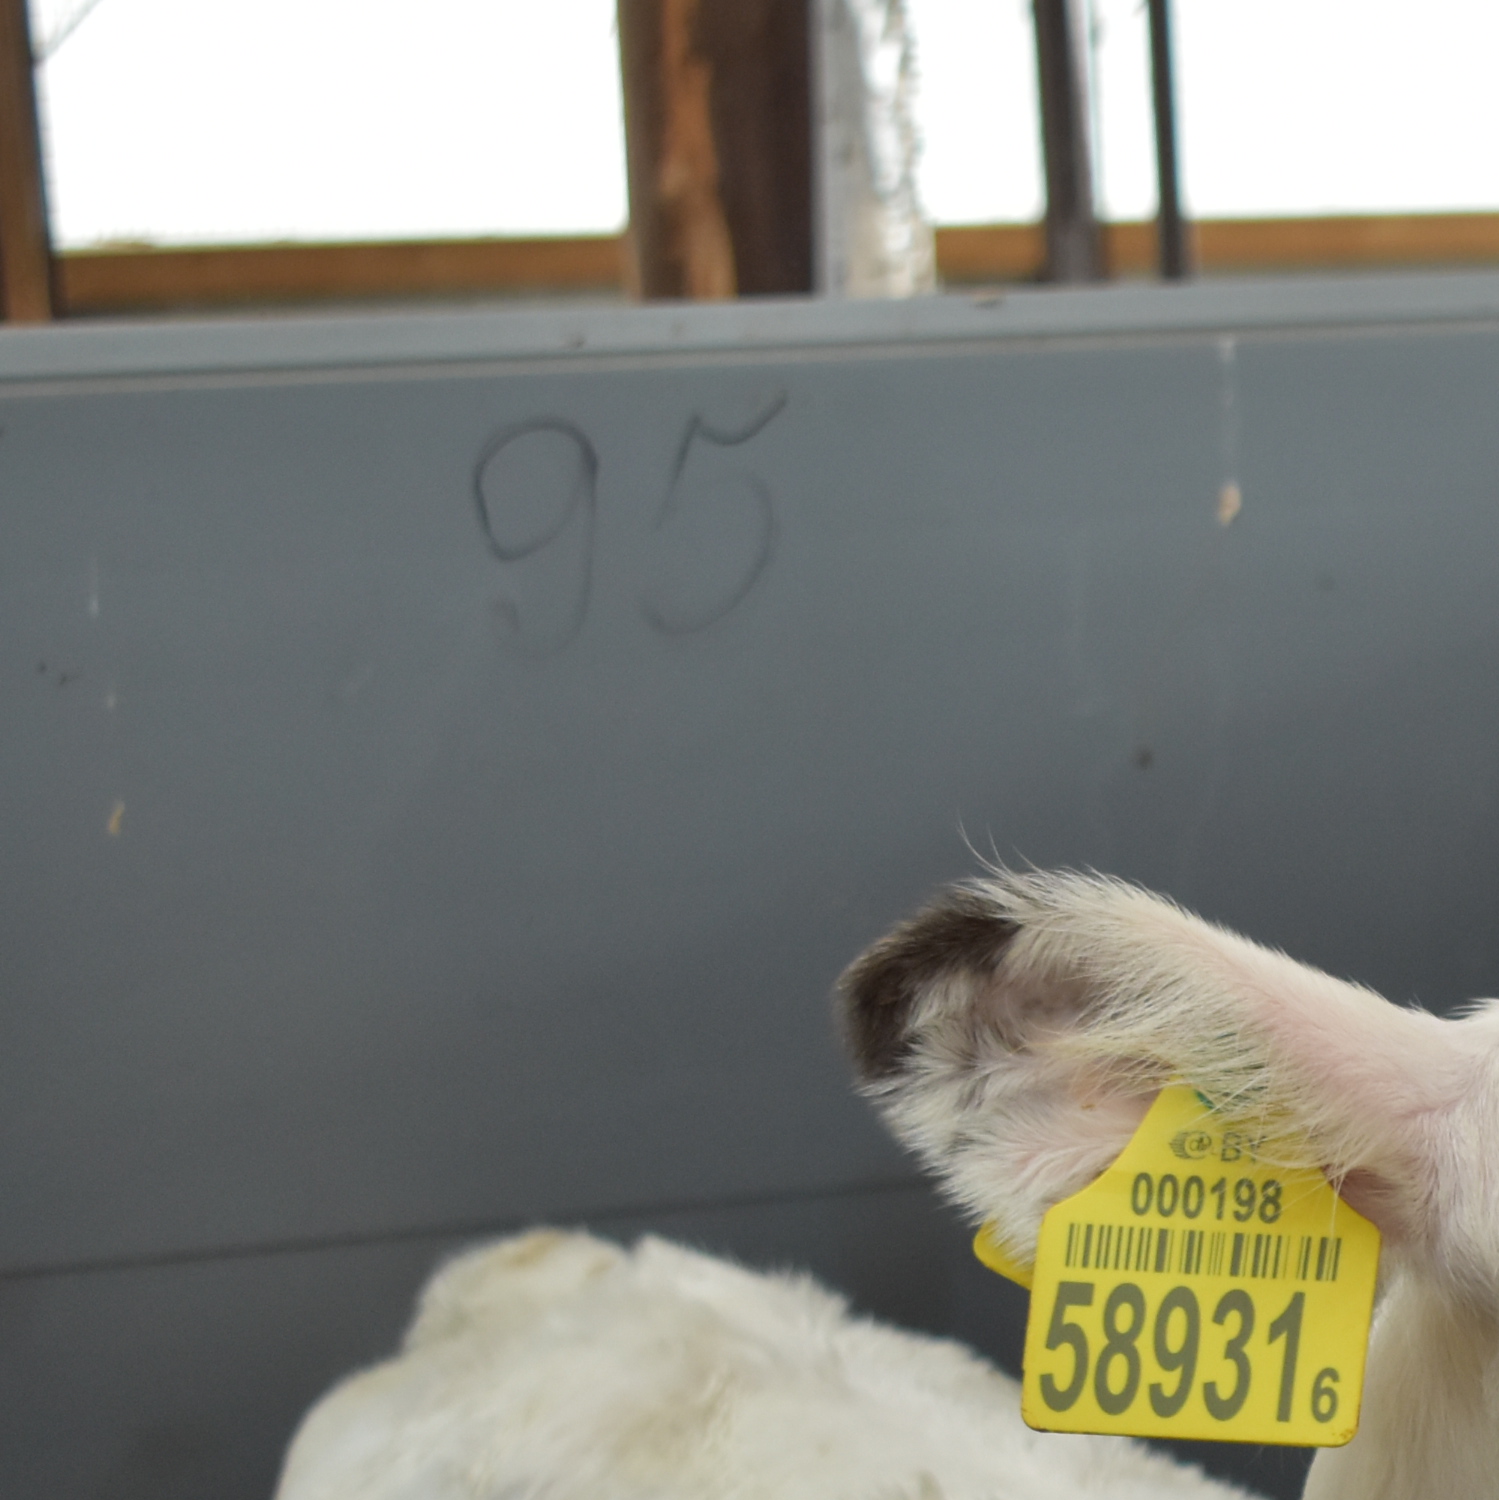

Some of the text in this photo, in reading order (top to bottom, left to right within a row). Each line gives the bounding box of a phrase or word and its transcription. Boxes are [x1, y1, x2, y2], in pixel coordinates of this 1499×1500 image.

[472, 388, 788, 659] 95
[1132, 1172, 1283, 1224] 000198
[1039, 1281, 1306, 1423] 58931
